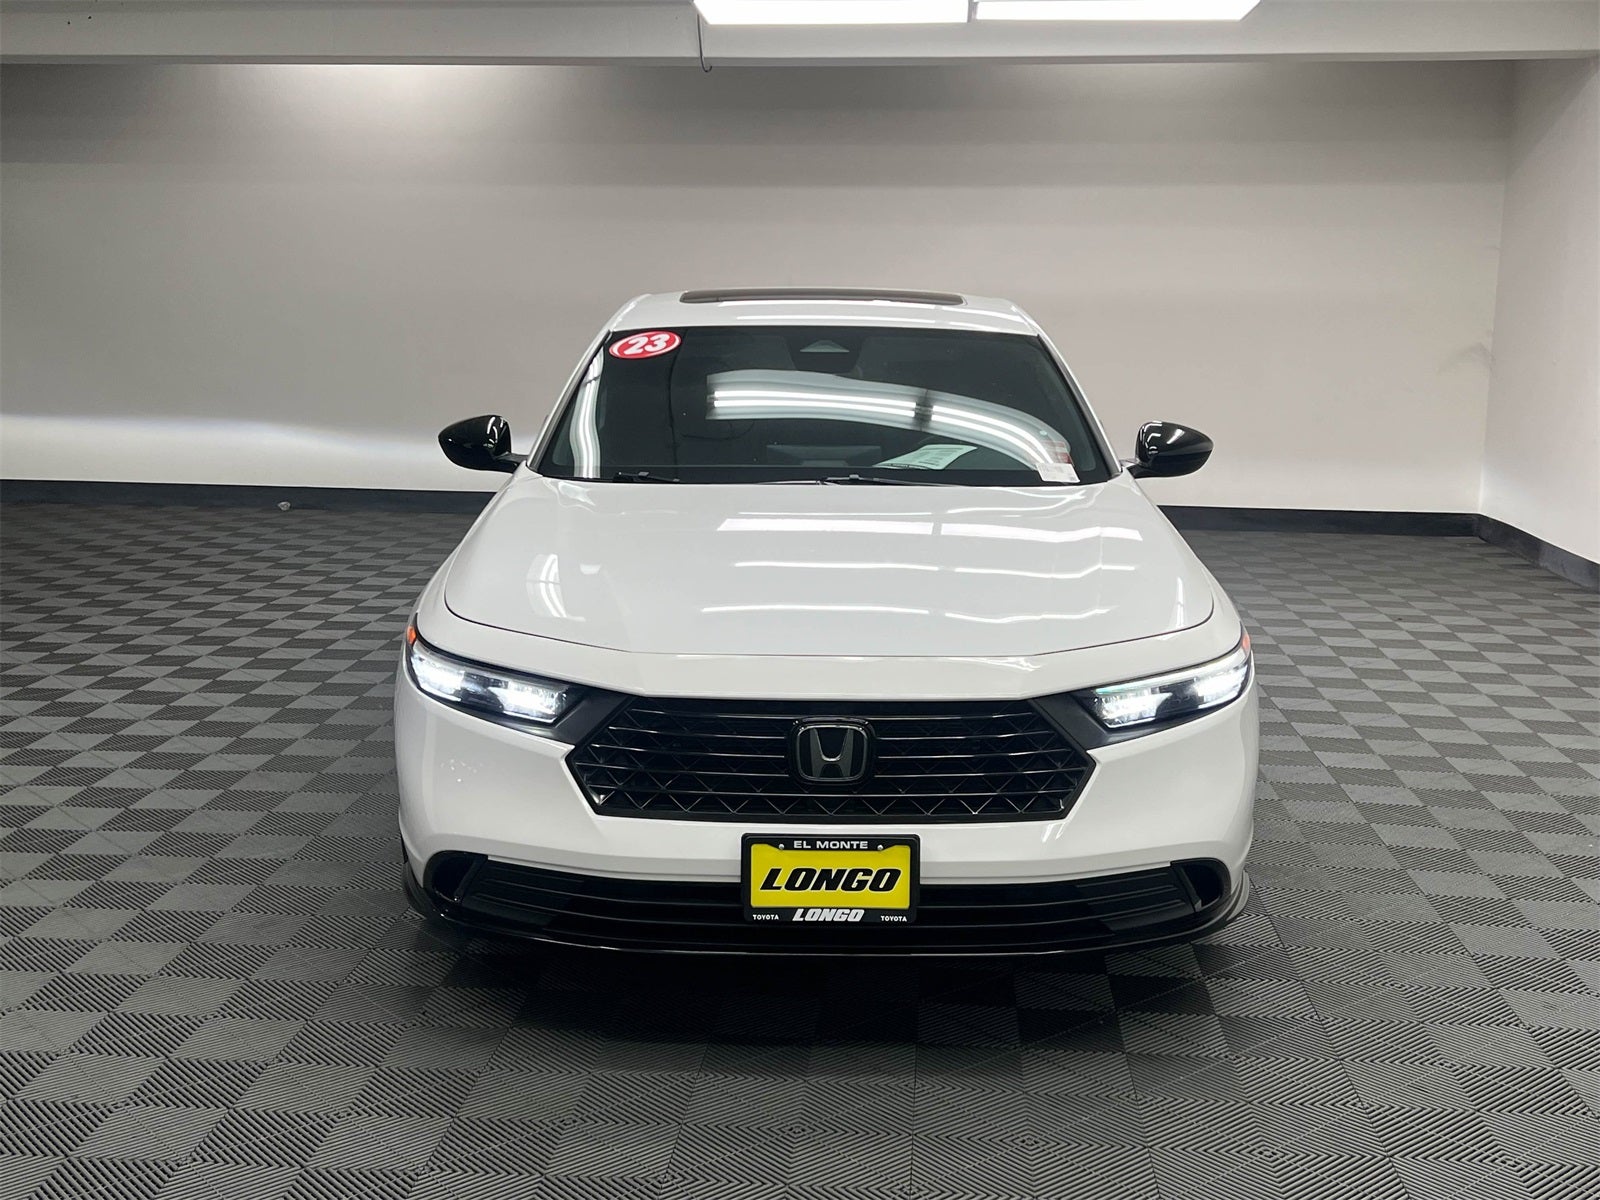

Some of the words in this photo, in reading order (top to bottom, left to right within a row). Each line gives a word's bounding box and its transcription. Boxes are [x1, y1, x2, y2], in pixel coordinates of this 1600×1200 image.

[623, 333, 670, 355] 23
[793, 841, 812, 849] EL
[816, 841, 869, 849] MONTE
[760, 868, 901, 892] LONGO
[792, 908, 865, 922] LONGO
